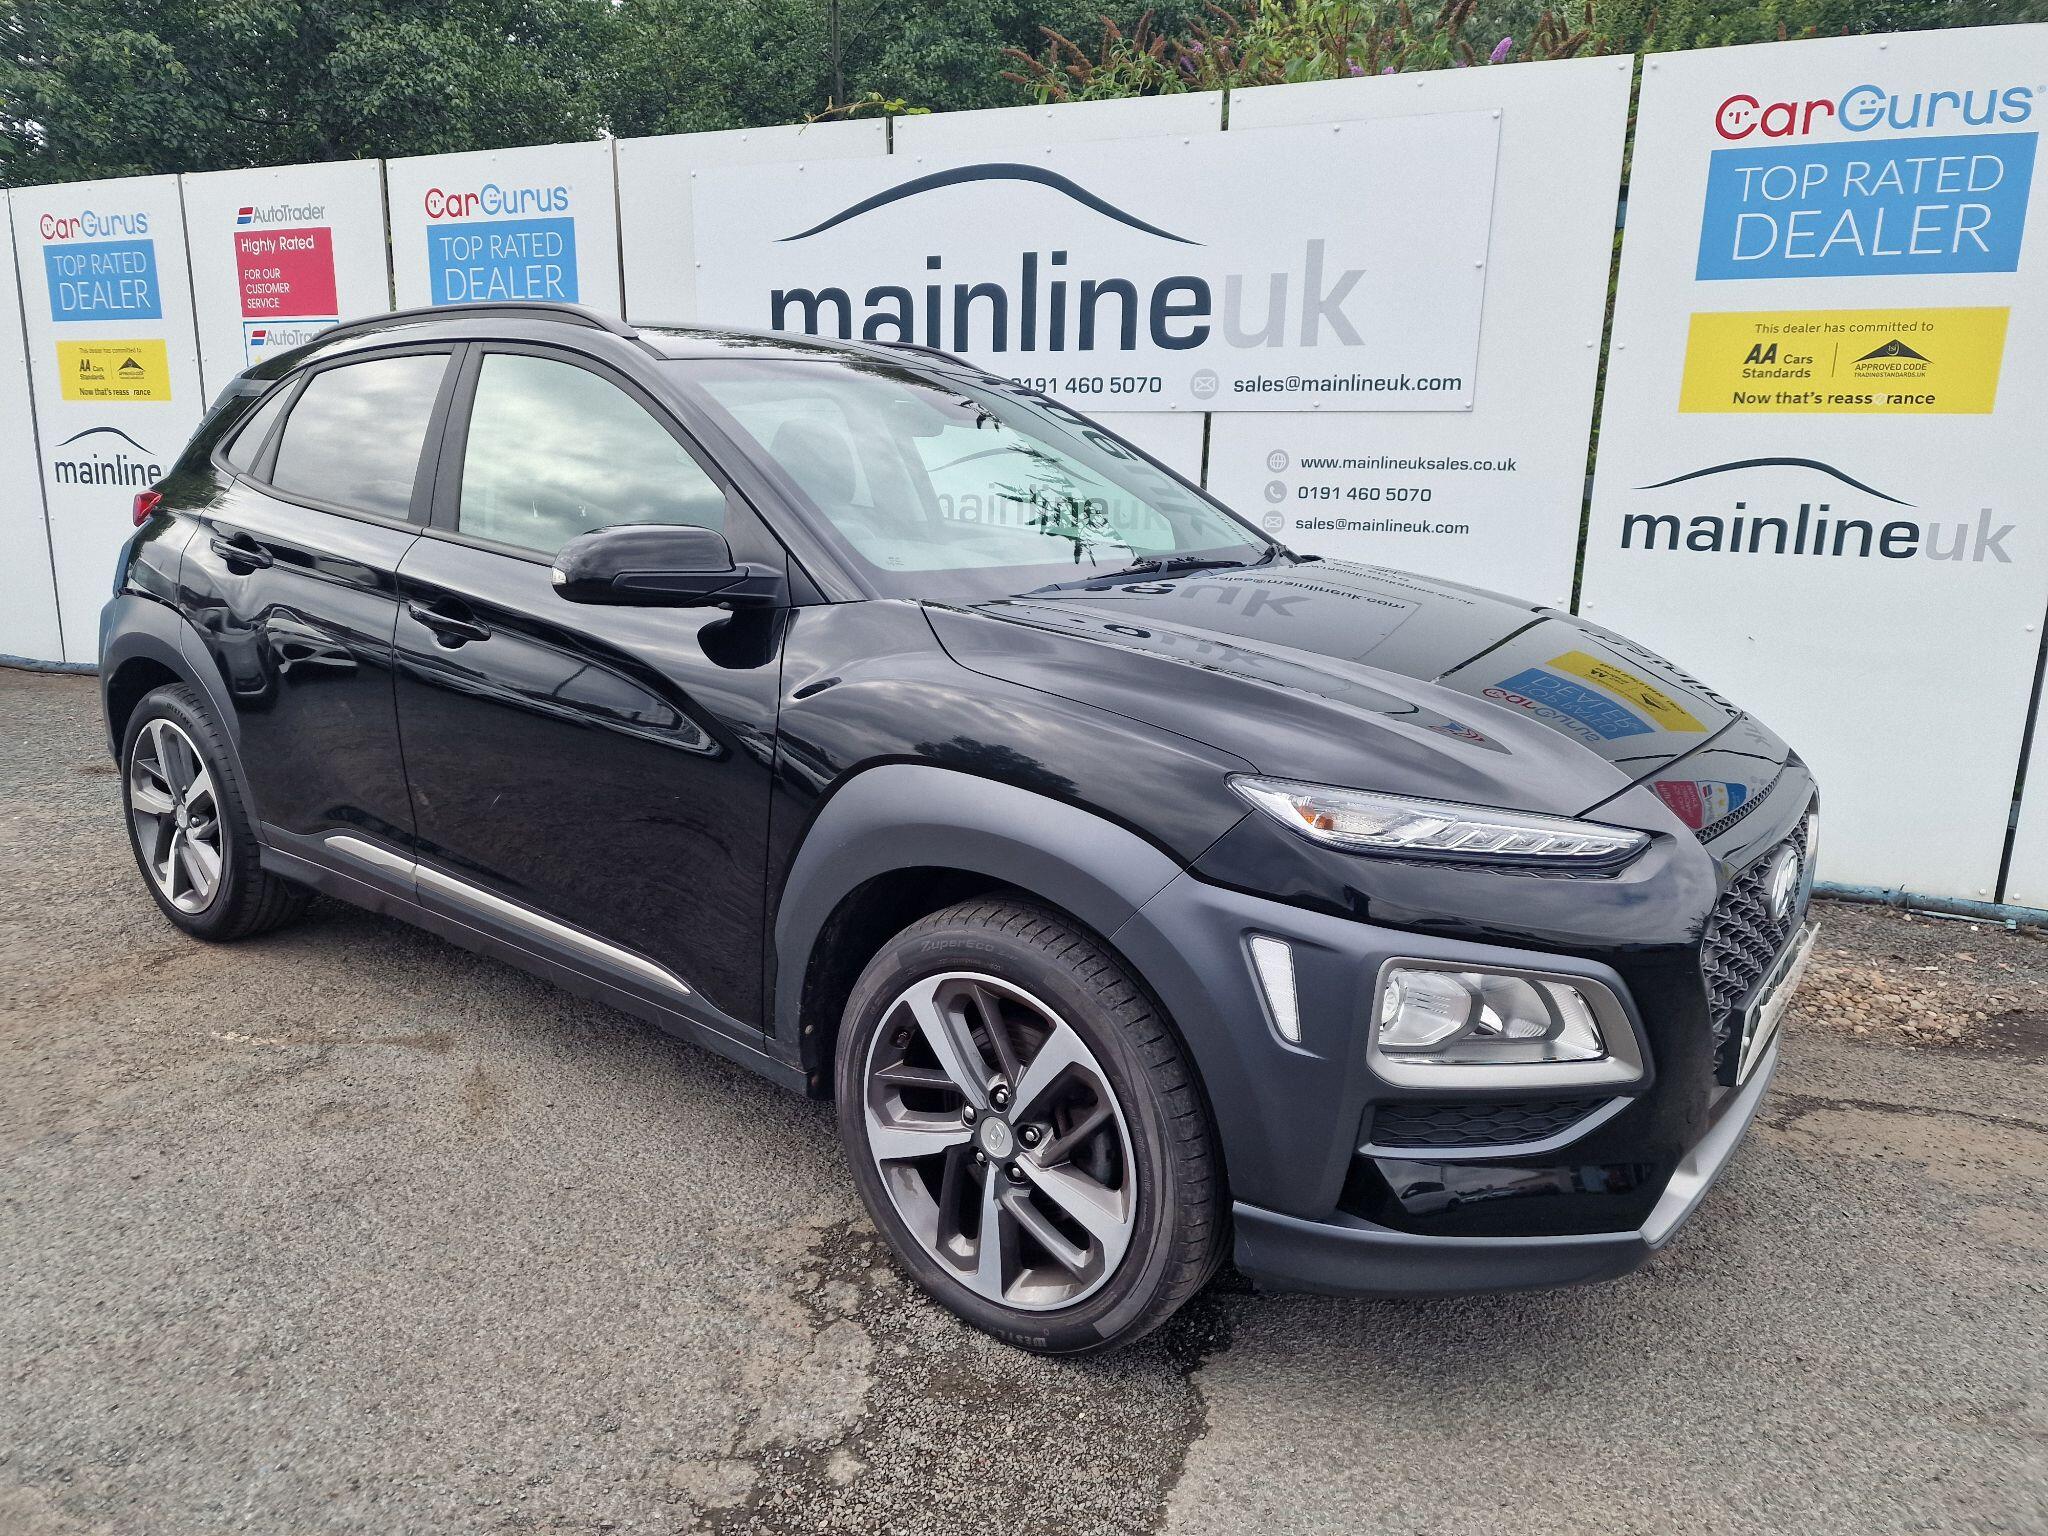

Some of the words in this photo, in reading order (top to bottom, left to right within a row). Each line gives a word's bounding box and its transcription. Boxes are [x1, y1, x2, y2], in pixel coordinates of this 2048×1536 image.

[1714, 84, 2034, 140] CarGurus
[1734, 163, 1828, 202] TOP
[1842, 153, 2003, 197] RATED
[425, 183, 569, 219] CarGurus
[253, 203, 326, 224] AutoTrader
[40, 210, 148, 240] CarGurus
[1731, 202, 1992, 261] DEALER
[241, 238, 276, 255] Highly
[279, 235, 315, 250] Rated
[439, 235, 484, 262] TOP
[489, 230, 564, 259] RATED
[53, 255, 86, 278] TOP
[91, 251, 147, 275] RATED
[244, 269, 261, 280] FOR
[263, 268, 281, 279] OUR
[246, 283, 290, 294] CUSTOMER
[445, 263, 566, 302] DEALER
[59, 279, 151, 312] DEALER
[247, 298, 280, 309] SERVICE
[1754, 323, 1779, 334] This
[1783, 323, 1821, 334] dealer
[1823, 322, 1845, 333] has
[1849, 322, 1918, 333] committed
[1921, 322, 1935, 332] to
[1743, 342, 1778, 365] AA
[1783, 353, 1814, 365] Cars
[79, 359, 91, 372] AA
[1741, 367, 1812, 379] Standards
[1855, 363, 1902, 371] APPROVED
[1903, 362, 1928, 371] CODE
[1065, 377, 1104, 394] 460
[1110, 376, 1162, 393] 5070
[1233, 373, 1463, 396] sales@mainlineuk.com
[1733, 391, 1773, 405] Now
[1300, 453, 1518, 475] www.mainlineuksales.co.uk
[1297, 485, 1342, 501] 0191
[1346, 485, 1381, 502] 460
[1385, 486, 1433, 503] 5070
[1295, 516, 1470, 535] sales@mainlineuk.com
[1621, 501, 2017, 564] mainlineuk
